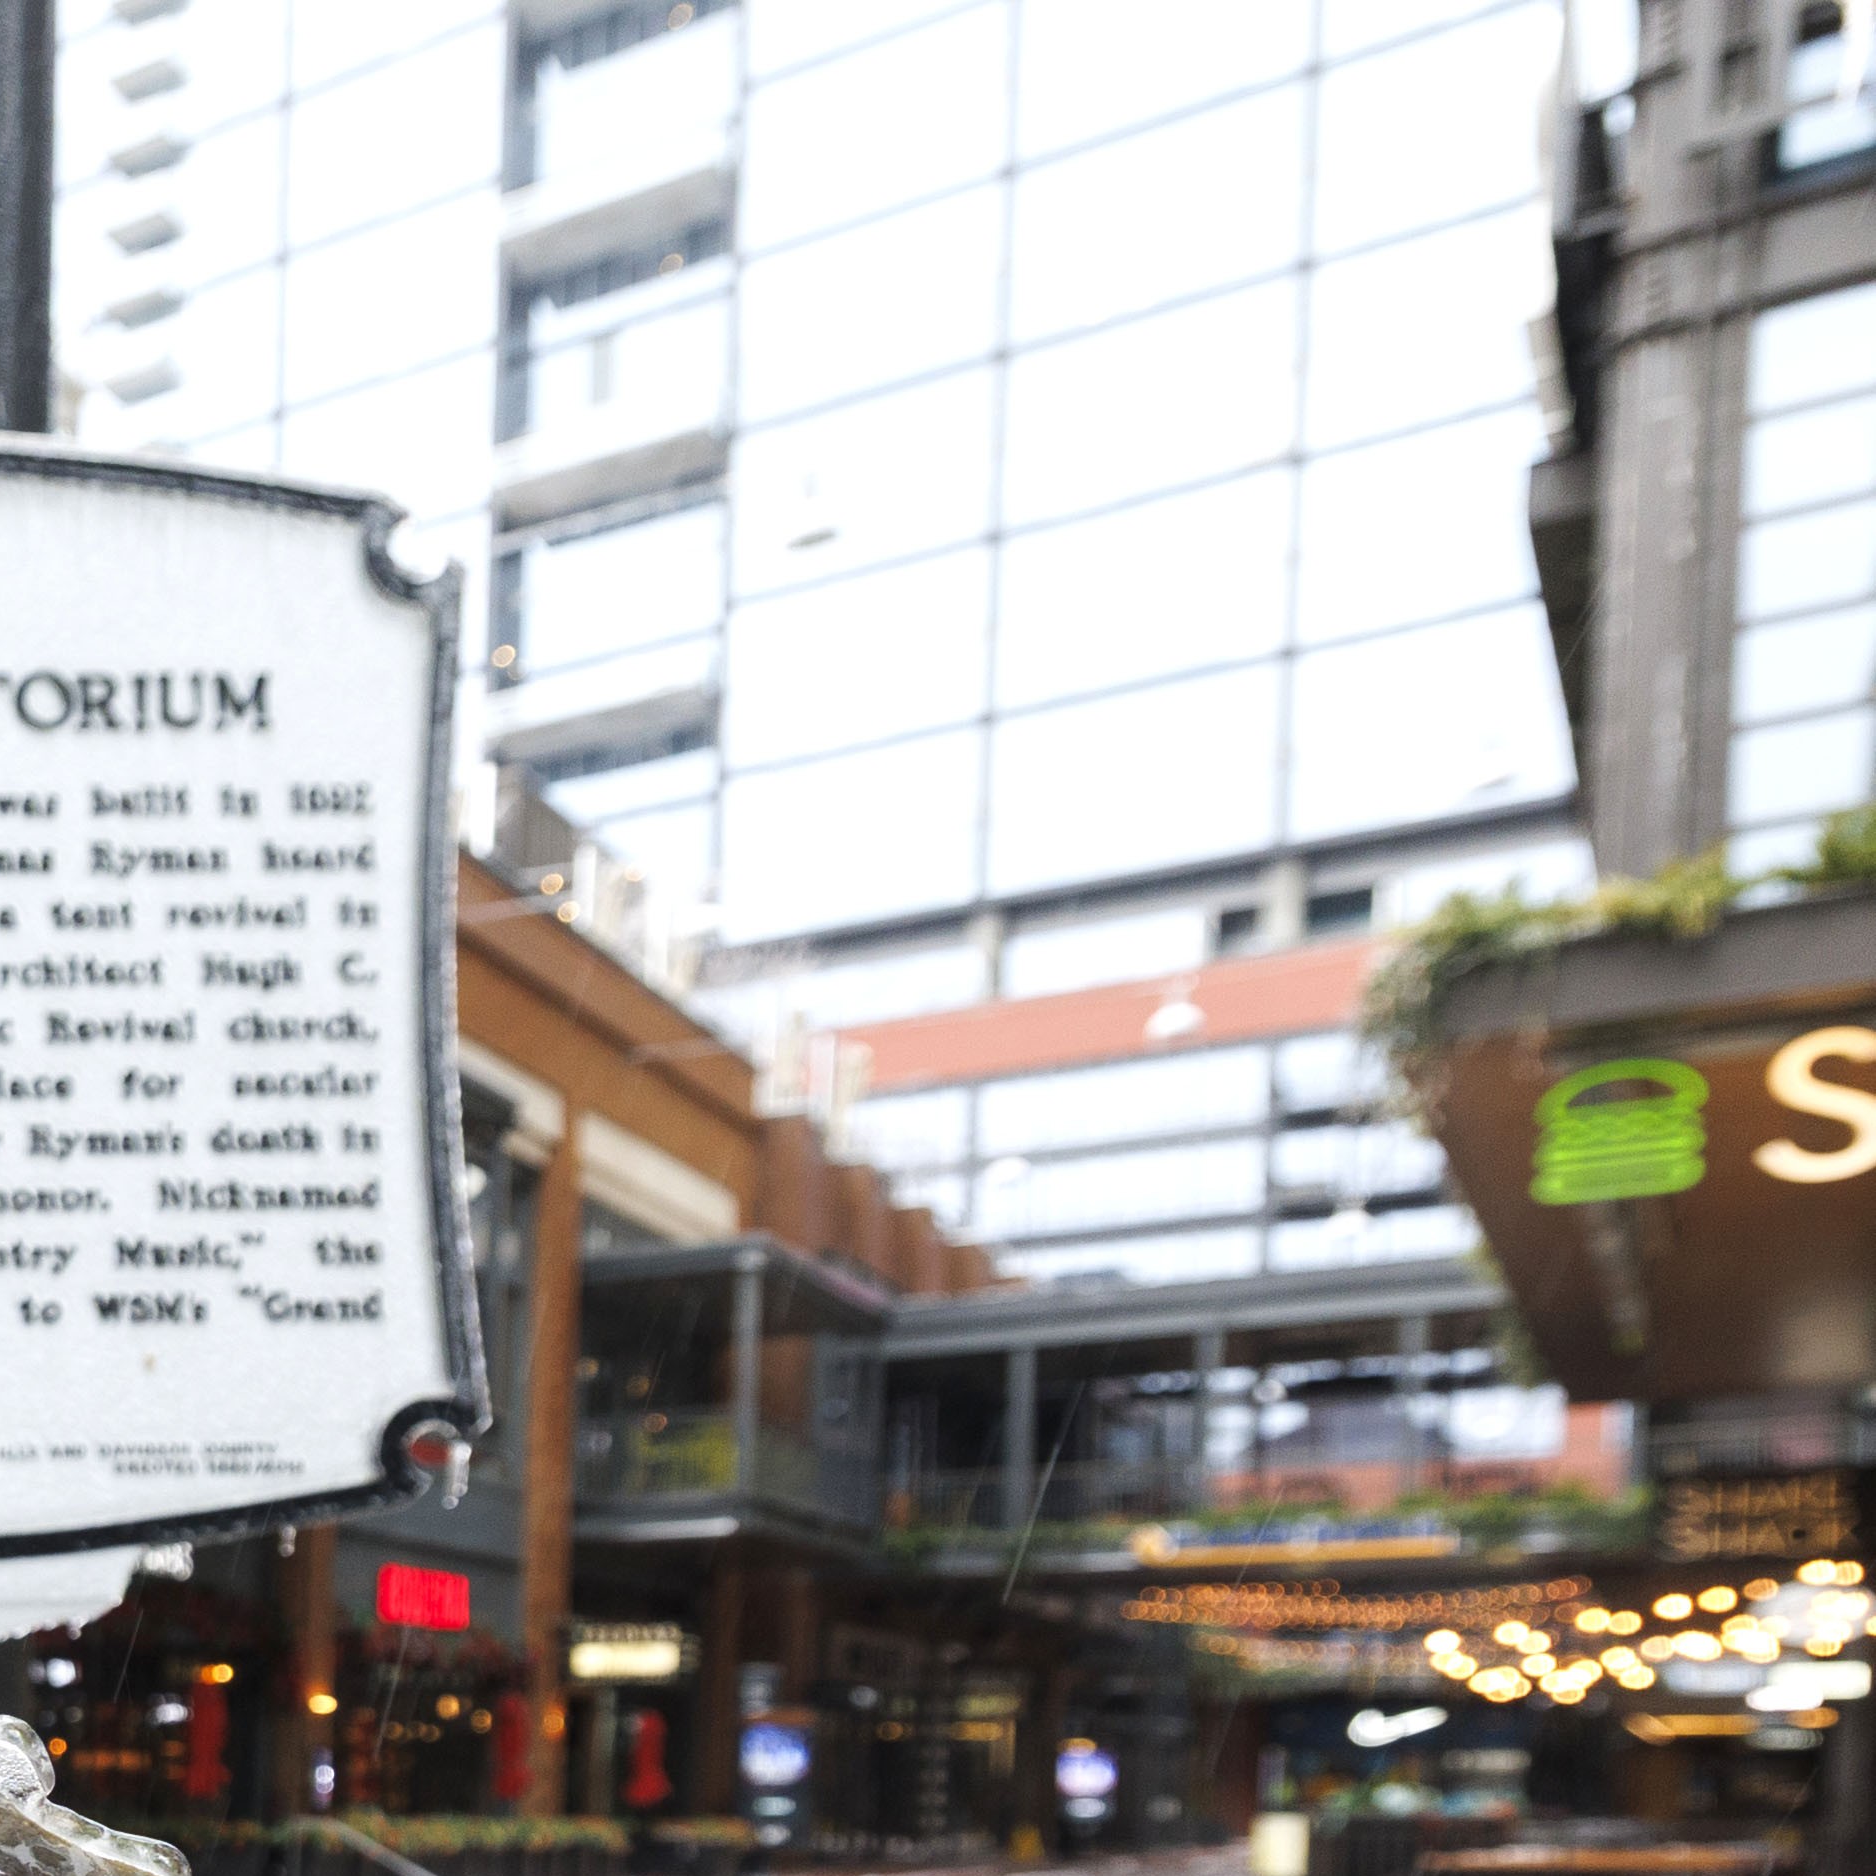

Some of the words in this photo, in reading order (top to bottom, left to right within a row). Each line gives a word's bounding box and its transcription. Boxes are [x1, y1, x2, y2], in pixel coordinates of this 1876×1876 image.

[91, 786, 189, 817] built
[220, 786, 257, 818] in
[89, 842, 227, 879] Ryman
[262, 842, 375, 872] heard
[49, 902, 132, 930] tent
[167, 898, 305, 929] revival
[339, 898, 377, 928] in
[201, 954, 300, 993] Hugh
[337, 953, 376, 985] C.
[46, 1012, 194, 1044] Revival
[121, 1069, 181, 1100] for
[233, 1066, 377, 1098] secular
[1753, 1025, 1876, 1183] S
[208, 1123, 321, 1155] death
[341, 1124, 379, 1154] in
[157, 1179, 380, 1212] Nicknamed
[313, 1237, 382, 1267] the
[18, 1298, 61, 1326] to
